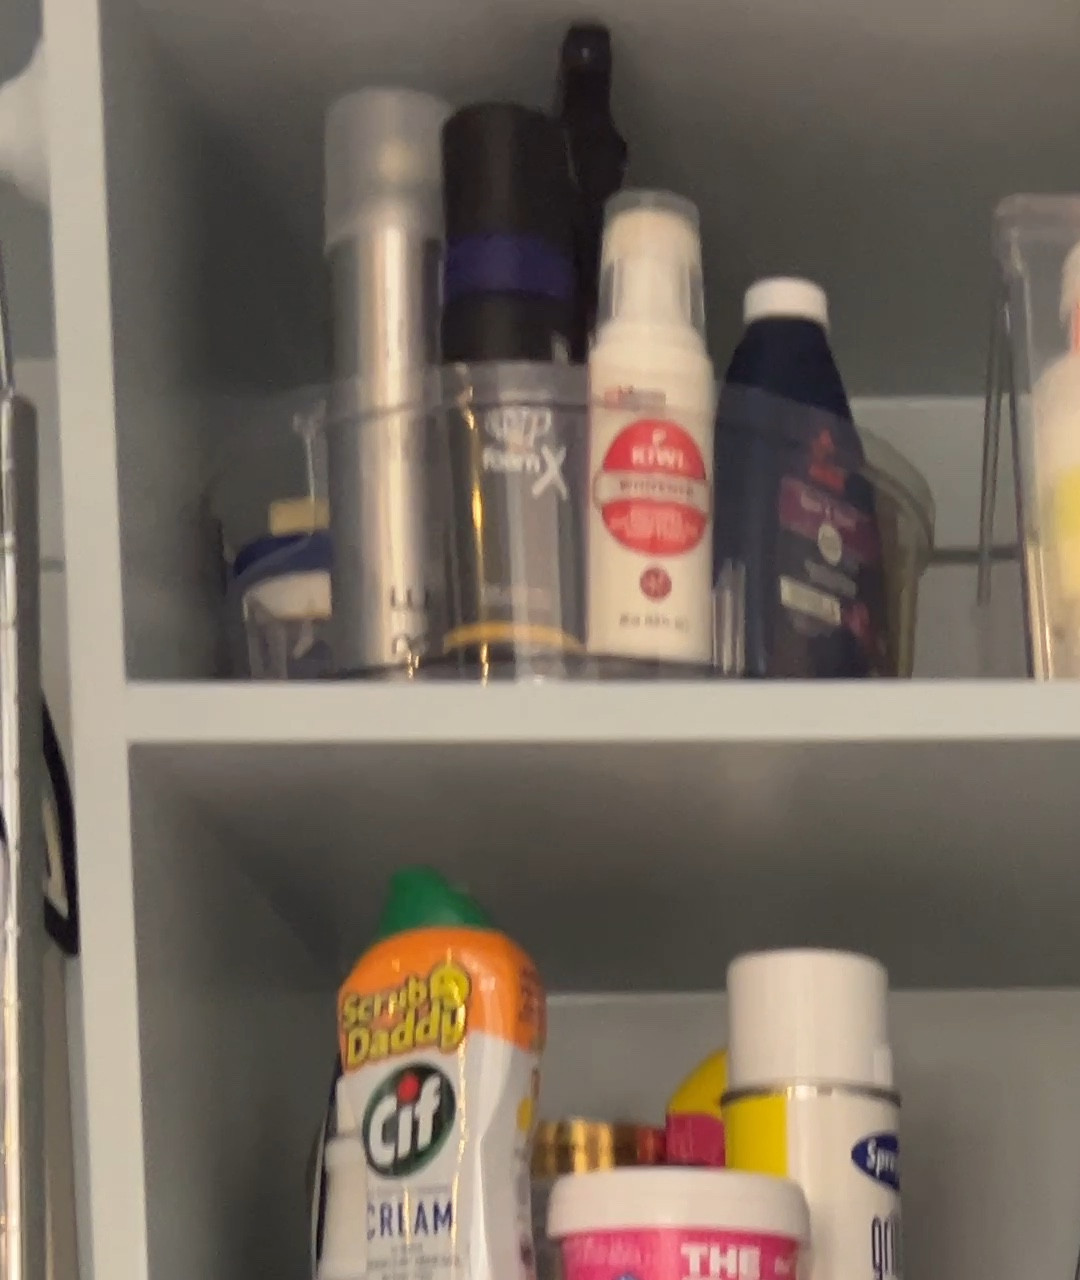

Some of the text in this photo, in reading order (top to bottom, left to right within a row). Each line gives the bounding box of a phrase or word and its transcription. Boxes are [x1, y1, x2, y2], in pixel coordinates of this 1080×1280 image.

[631, 445, 684, 468] KIWI
[342, 974, 429, 1029] Scrub
[347, 999, 467, 1068] Daddy
[368, 1072, 443, 1167] Cif
[680, 1243, 761, 1280] THE
